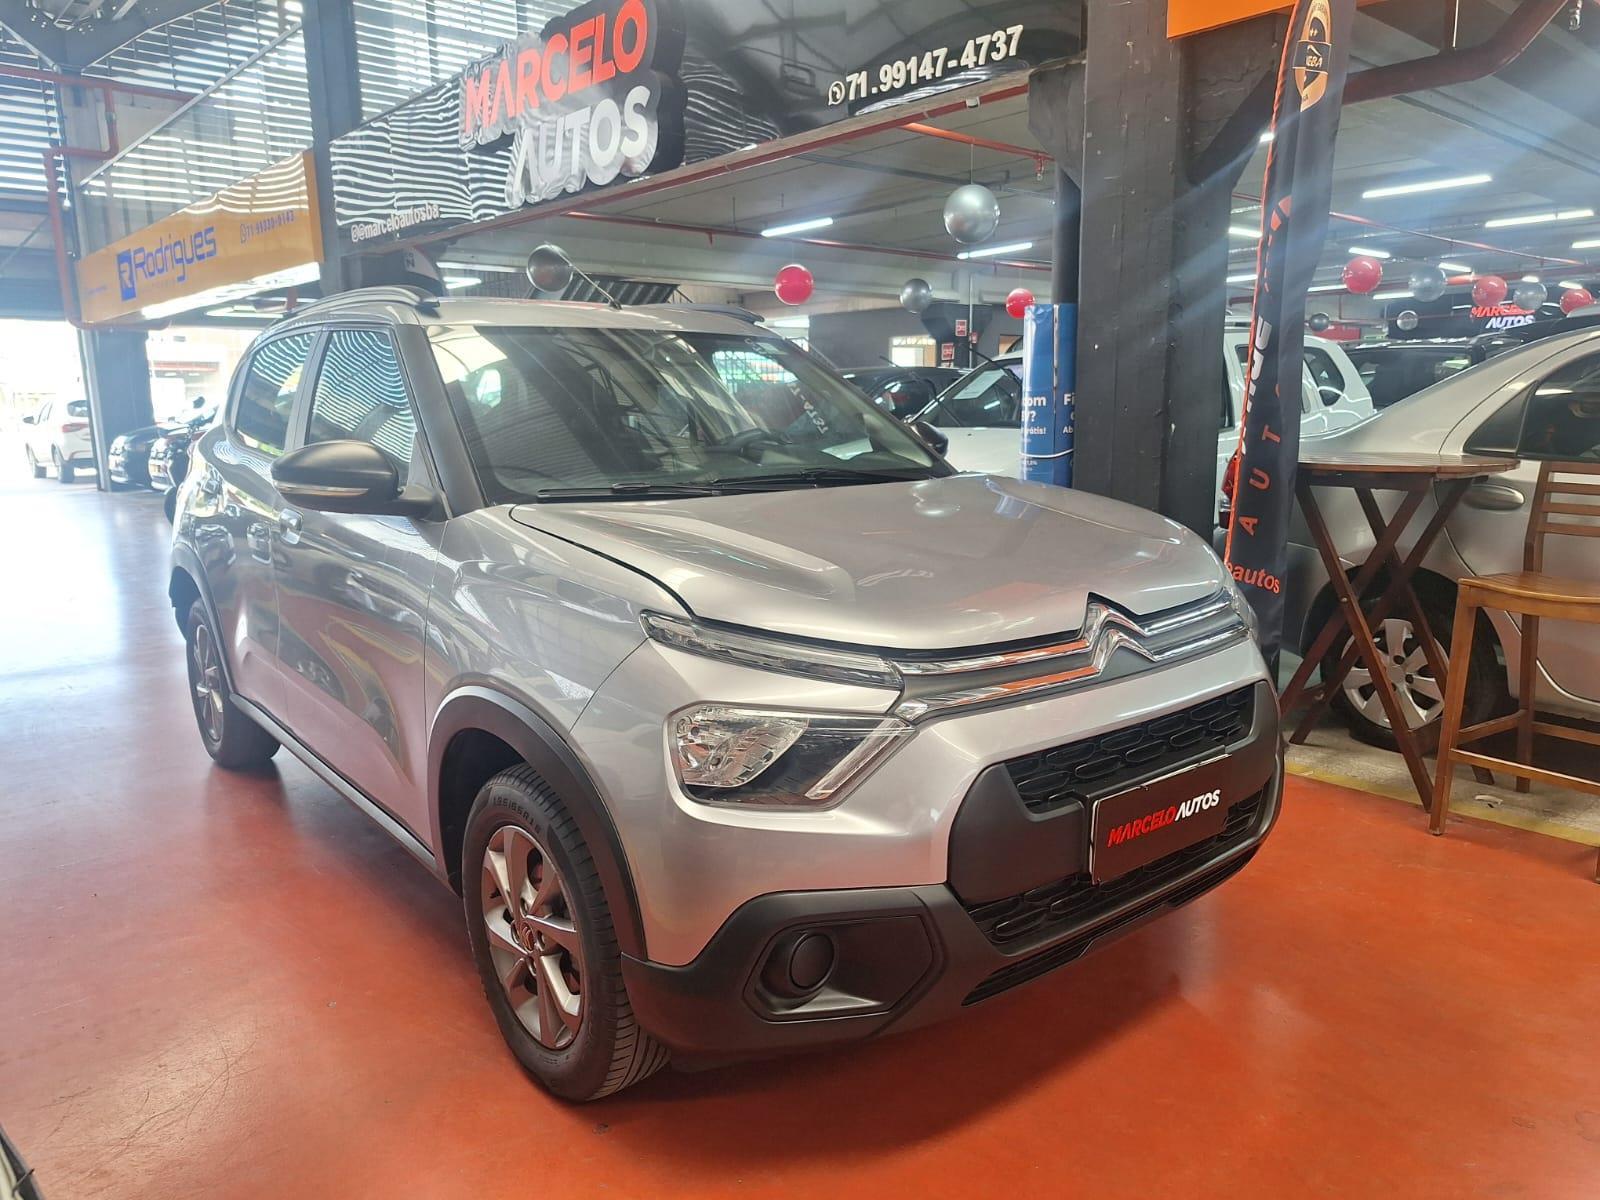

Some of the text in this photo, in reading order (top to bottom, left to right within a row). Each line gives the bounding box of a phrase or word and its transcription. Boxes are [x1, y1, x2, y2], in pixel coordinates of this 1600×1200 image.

[464, 0, 649, 134] MARCELO
[846, 24, 1025, 101] 71.99147-4737
[512, 84, 652, 194] AUTOS
[133, 226, 217, 282] Rodrigues
[1471, 303, 1536, 319] MARCE
[1485, 315, 1535, 329] AUTOS
